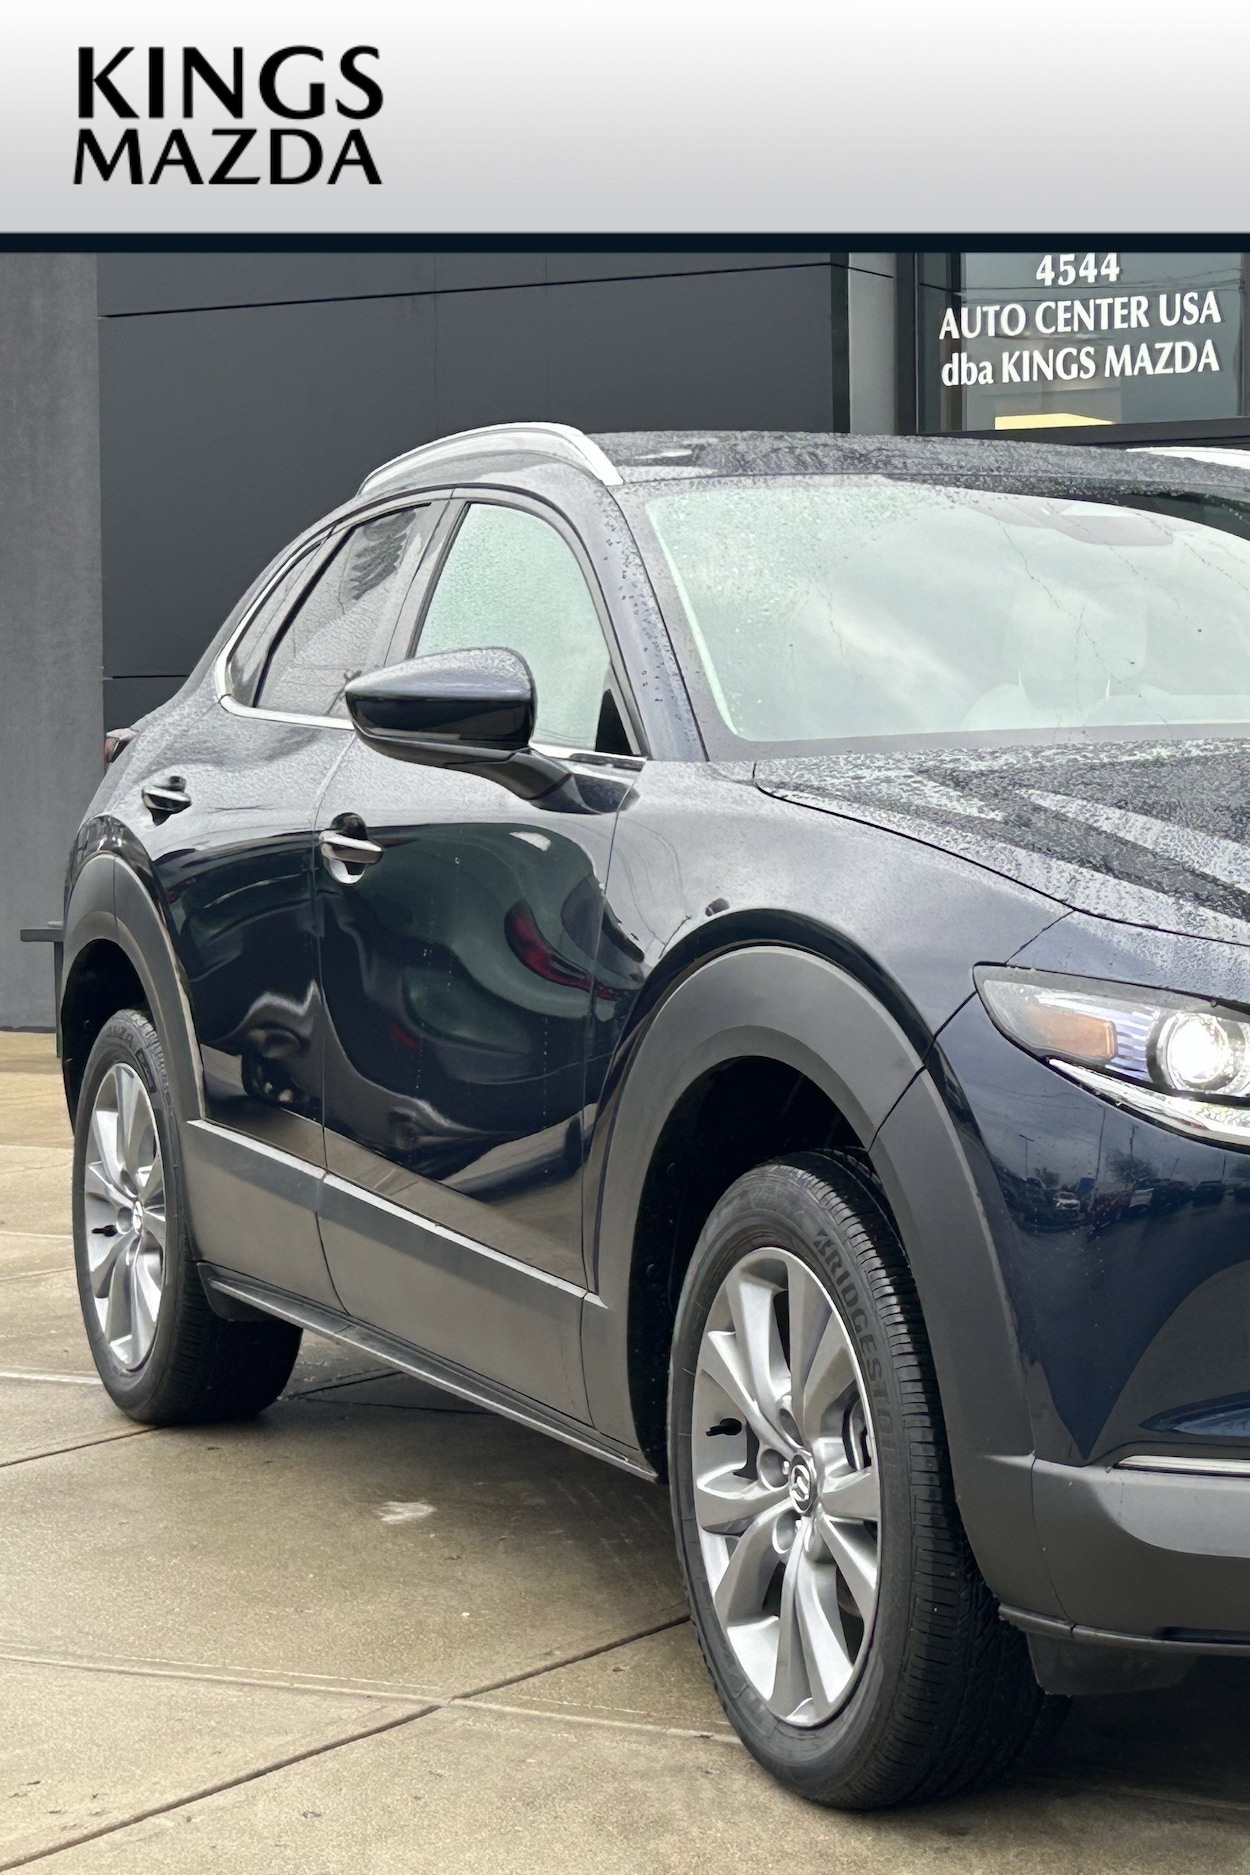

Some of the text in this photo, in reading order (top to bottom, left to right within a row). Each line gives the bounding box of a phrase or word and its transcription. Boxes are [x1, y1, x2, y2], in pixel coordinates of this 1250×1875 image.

[1035, 252, 1120, 286] 4544
[939, 290, 1222, 341] AUTO CENTER USA
[941, 339, 1221, 387] dba KINGS MAZDA
